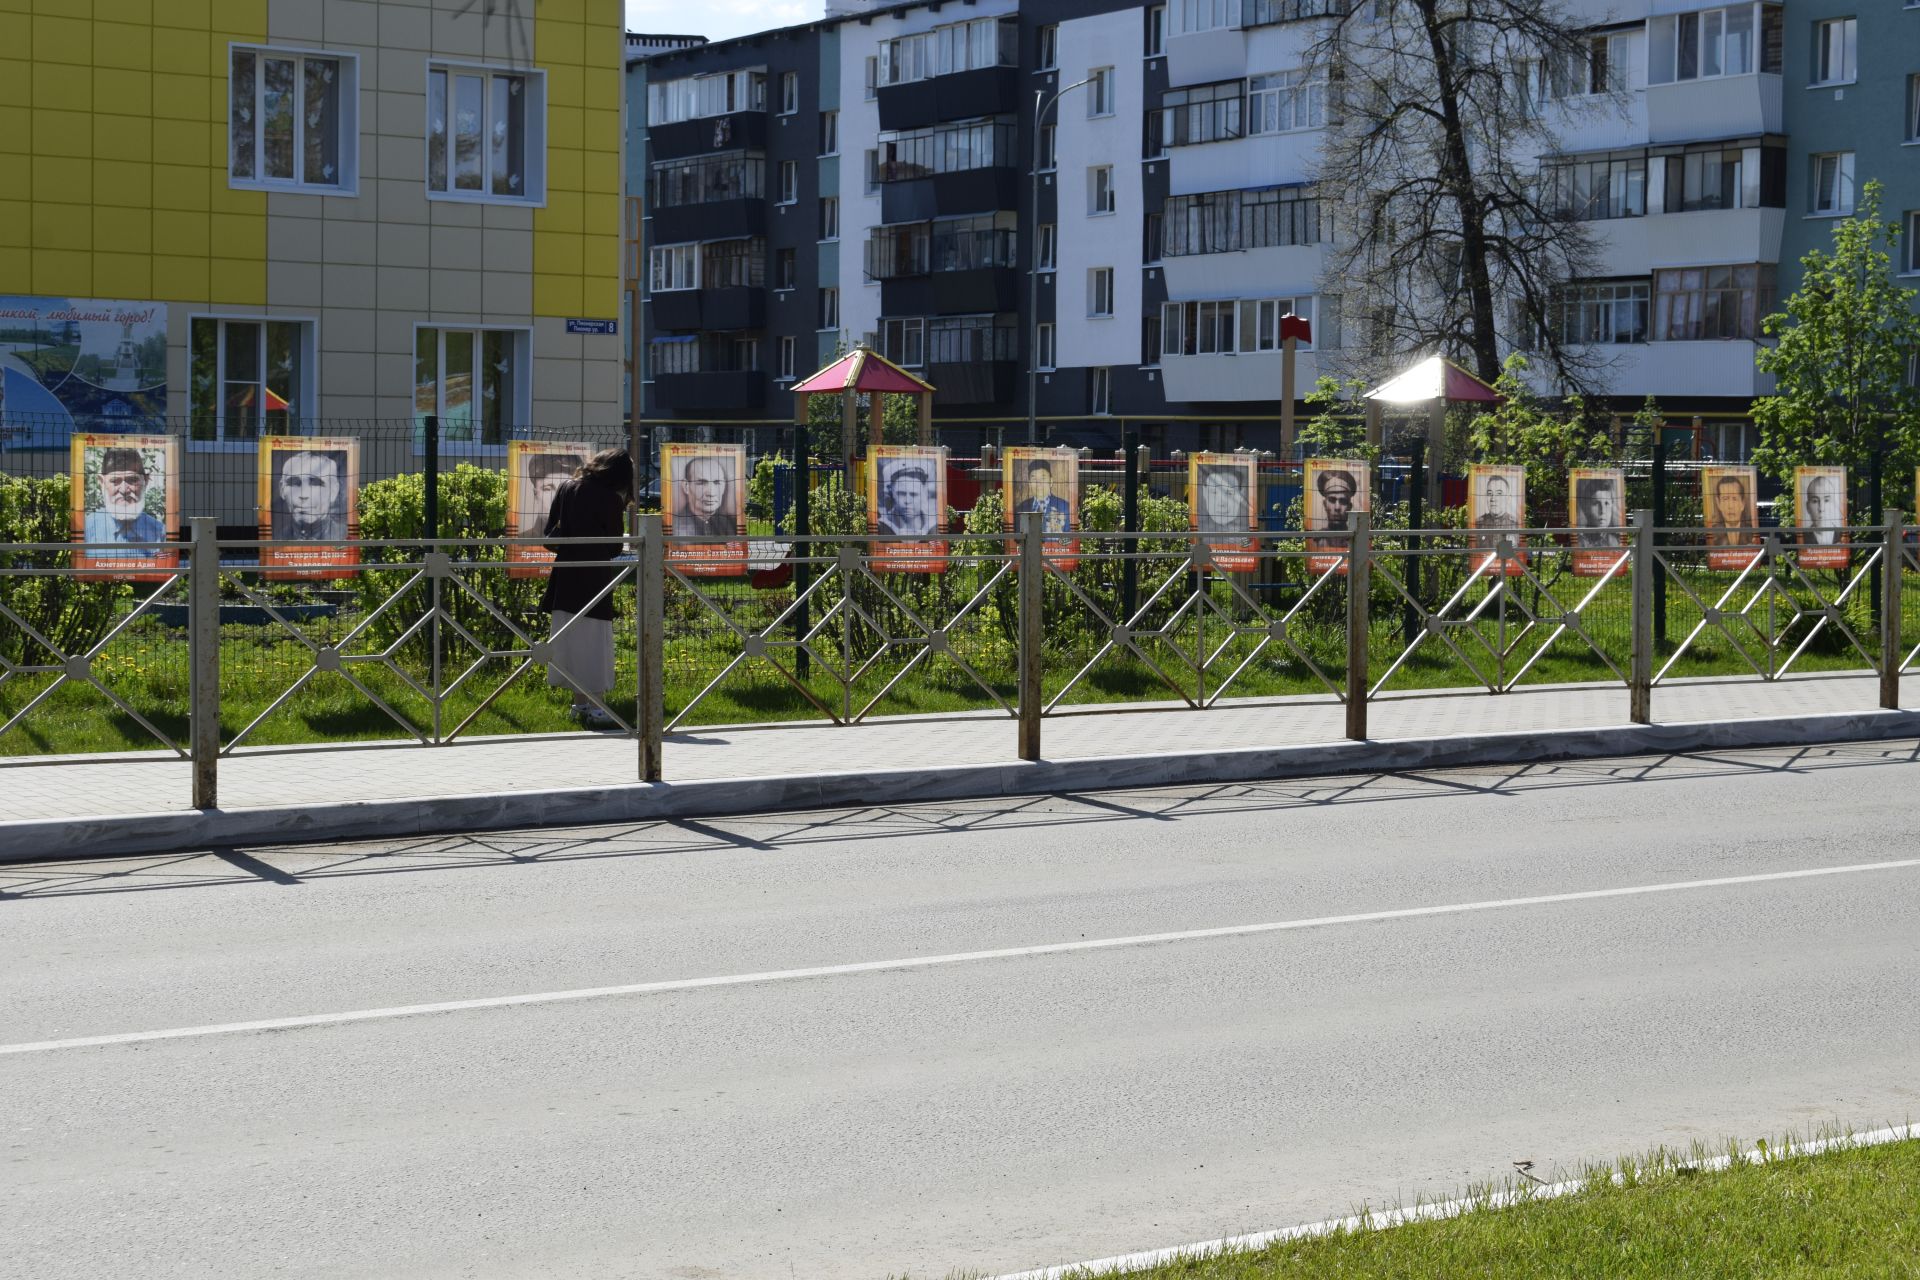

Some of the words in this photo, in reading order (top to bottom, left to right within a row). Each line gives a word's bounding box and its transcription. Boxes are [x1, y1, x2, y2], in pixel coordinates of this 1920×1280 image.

[46, 307, 110, 322] любимый
[114, 308, 154, 327] город!
[608, 322, 614, 333] 8
